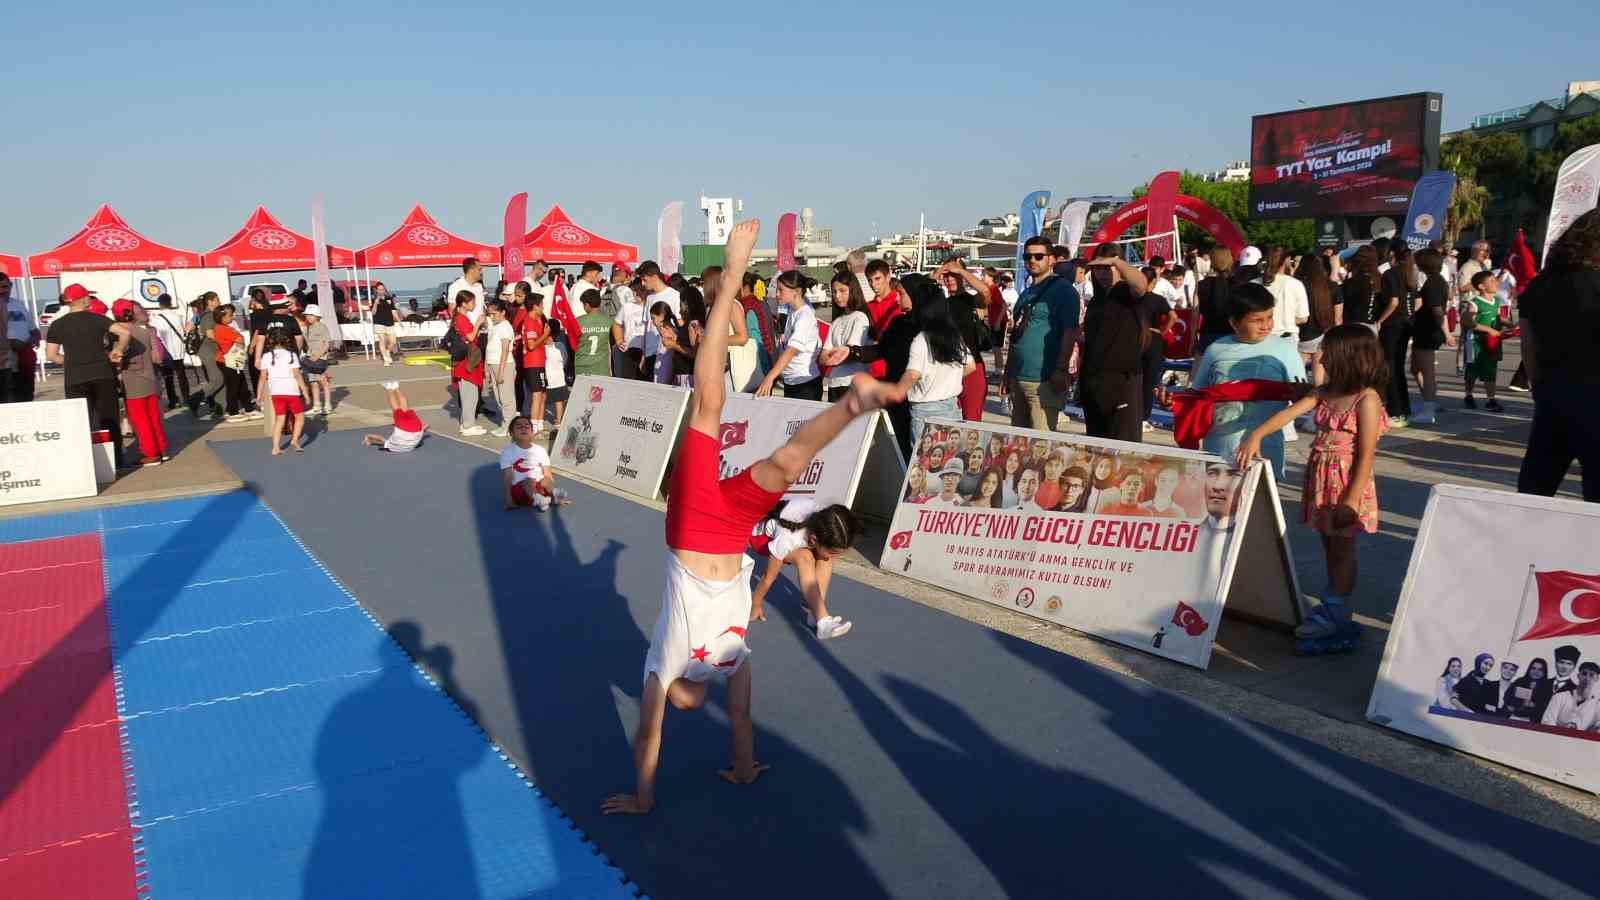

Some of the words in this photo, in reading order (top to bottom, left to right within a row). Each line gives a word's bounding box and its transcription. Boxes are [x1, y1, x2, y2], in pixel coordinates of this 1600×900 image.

[1276, 160, 1304, 178] TYT
[1306, 156, 1332, 172] Yaz
[1336, 139, 1392, 165] Kampı!
[916, 509, 1020, 540] TÜRKİYE'NİN
[1022, 515, 1083, 550] GÜCÜ,
[1087, 519, 1200, 553] GENÇLİĞİ
[946, 544, 955, 553] 19
[957, 546, 985, 557] MAYIS
[986, 549, 1036, 562] ATATÜRK'Ü
[1038, 554, 1068, 566] ANMA
[1120, 561, 1134, 573] VE
[952, 561, 974, 571] SPOR
[977, 563, 1036, 580] BAYRAMIMIZ
[1038, 571, 1071, 584] KUTLU
[1073, 575, 1112, 589] OLSUN!
